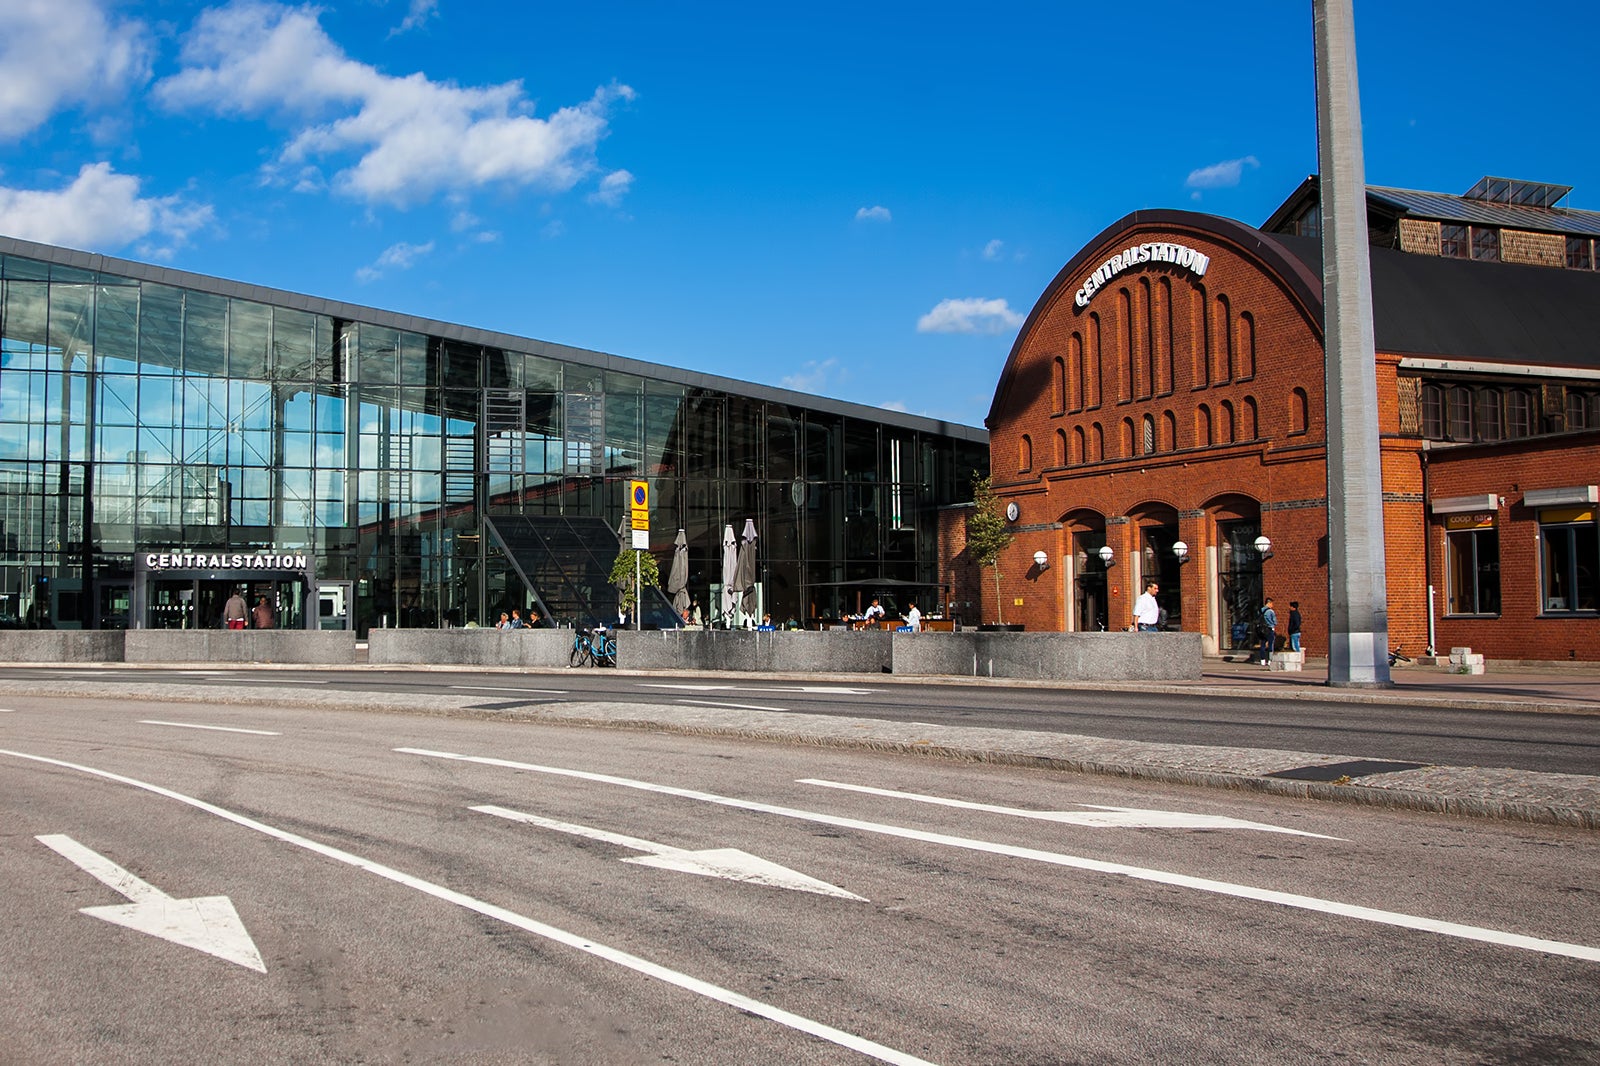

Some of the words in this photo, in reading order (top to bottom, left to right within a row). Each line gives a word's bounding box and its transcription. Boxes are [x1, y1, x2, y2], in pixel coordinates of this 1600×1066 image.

[1075, 242, 1210, 307] CENTRALSTATION
[1450, 515, 1471, 524] coop
[146, 553, 307, 568] CENTRALSTATION
